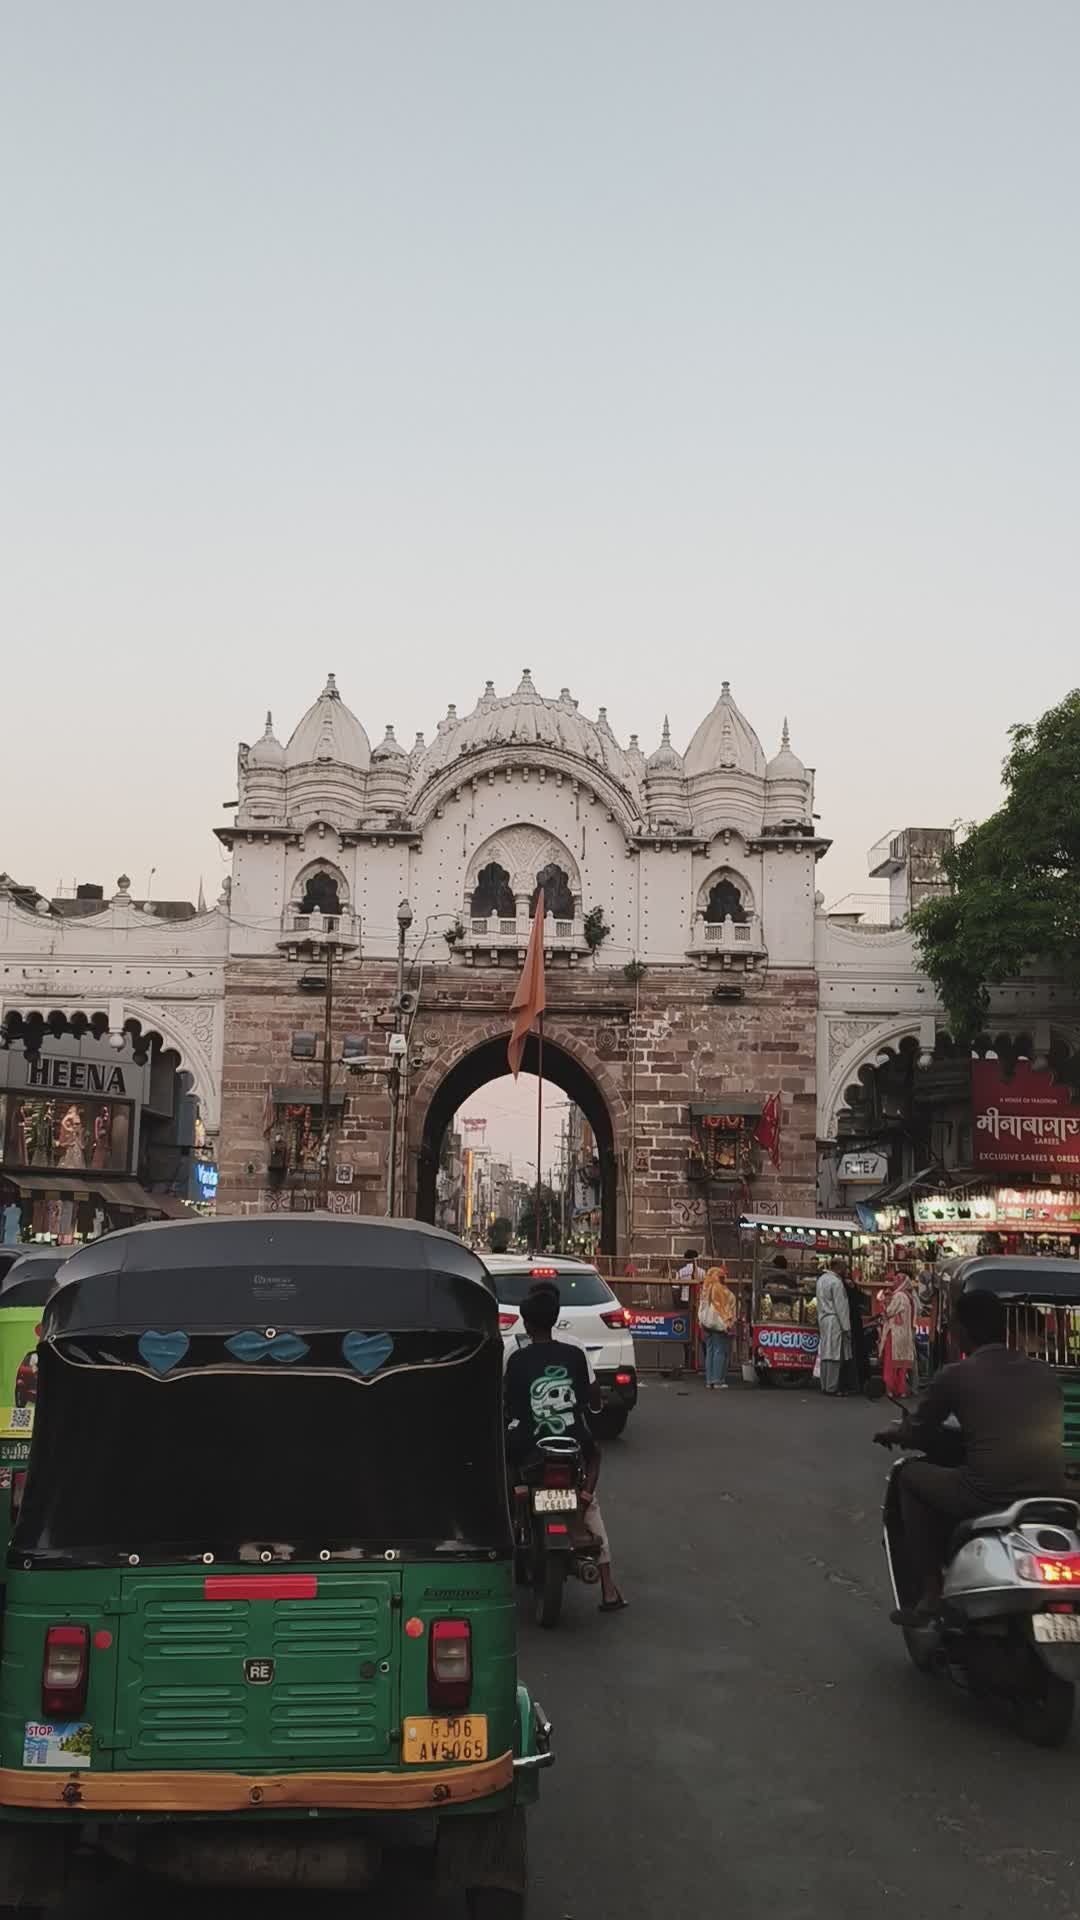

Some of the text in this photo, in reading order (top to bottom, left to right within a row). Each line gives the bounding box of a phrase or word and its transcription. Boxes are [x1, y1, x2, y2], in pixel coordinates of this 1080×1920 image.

[29, 1057, 126, 1095] HEENA
[980, 1153, 1019, 1161] EXCLUSIVE
[1020, 1154, 1047, 1162] SAREES
[1056, 1155, 1079, 1163] DRESS
[635, 1315, 665, 1325] POLICE
[250, 1666, 270, 1678] RE
[28, 1726, 53, 1736] STOP
[431, 1719, 472, 1738] GJ06
